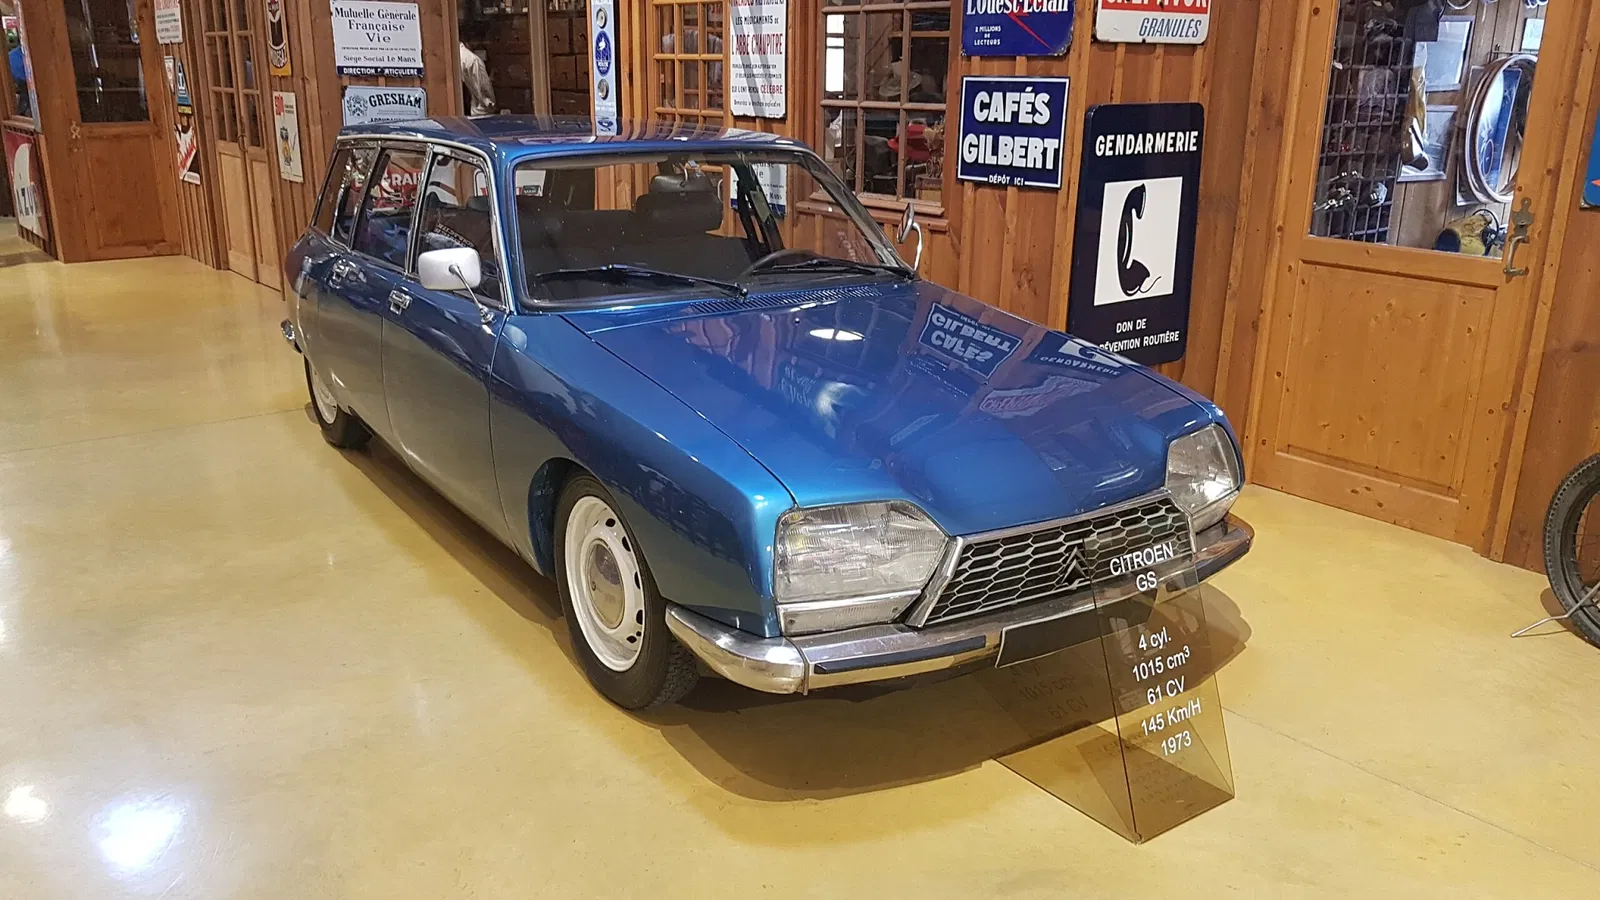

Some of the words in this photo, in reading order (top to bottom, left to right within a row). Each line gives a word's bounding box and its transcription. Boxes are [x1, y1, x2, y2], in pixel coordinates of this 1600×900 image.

[335, 7, 375, 19] Mutuelle
[377, 8, 416, 20] Générale
[348, 19, 405, 32] Française
[1139, 18, 1202, 38] GRANULÉS
[366, 32, 391, 43] Vie
[343, 67, 376, 75] DIRECTION
[368, 93, 422, 109] GRESHAM
[973, 86, 1051, 125] CAFÉS
[962, 133, 1060, 170] GILBERT
[1095, 130, 1199, 157] GENDARMERIE
[988, 174, 1010, 184] DÉPÔT
[1014, 177, 1024, 186] ICI
[1116, 321, 1134, 334] DON
[1135, 318, 1148, 330] DE
[1109, 541, 1174, 576] CITROEN
[1136, 571, 1158, 592] GS
[1138, 633, 1147, 651] 4
[1150, 626, 1172, 650] cyl.
[1132, 655, 1164, 682] 1015
[1147, 684, 1163, 705] 61
[1166, 675, 1185, 697] CV
[1141, 712, 1165, 736] 145
[1166, 697, 1202, 726] Km/H
[1161, 730, 1192, 757] 1973
